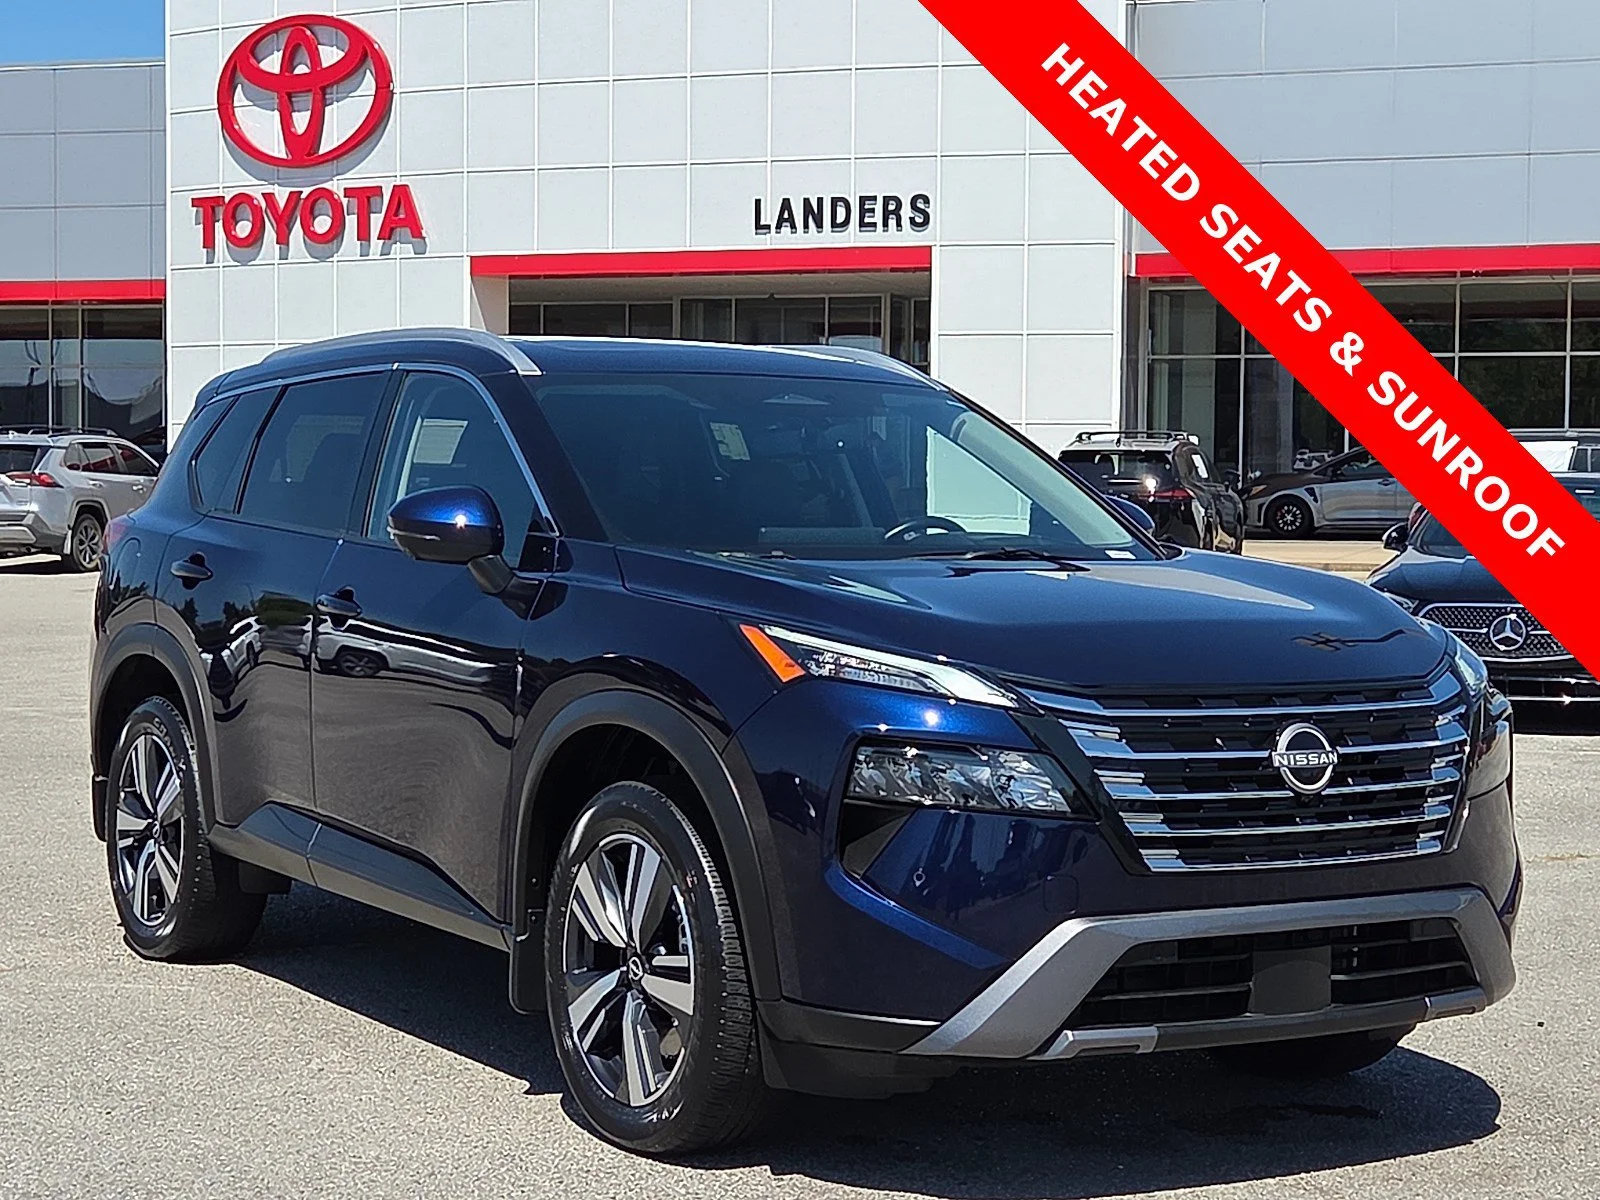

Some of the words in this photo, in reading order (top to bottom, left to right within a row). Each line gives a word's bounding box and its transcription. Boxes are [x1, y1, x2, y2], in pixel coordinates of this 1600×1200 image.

[191, 184, 425, 249] TOYOTA
[755, 194, 931, 234] LANDERS
[1274, 751, 1337, 766] NISSAN
